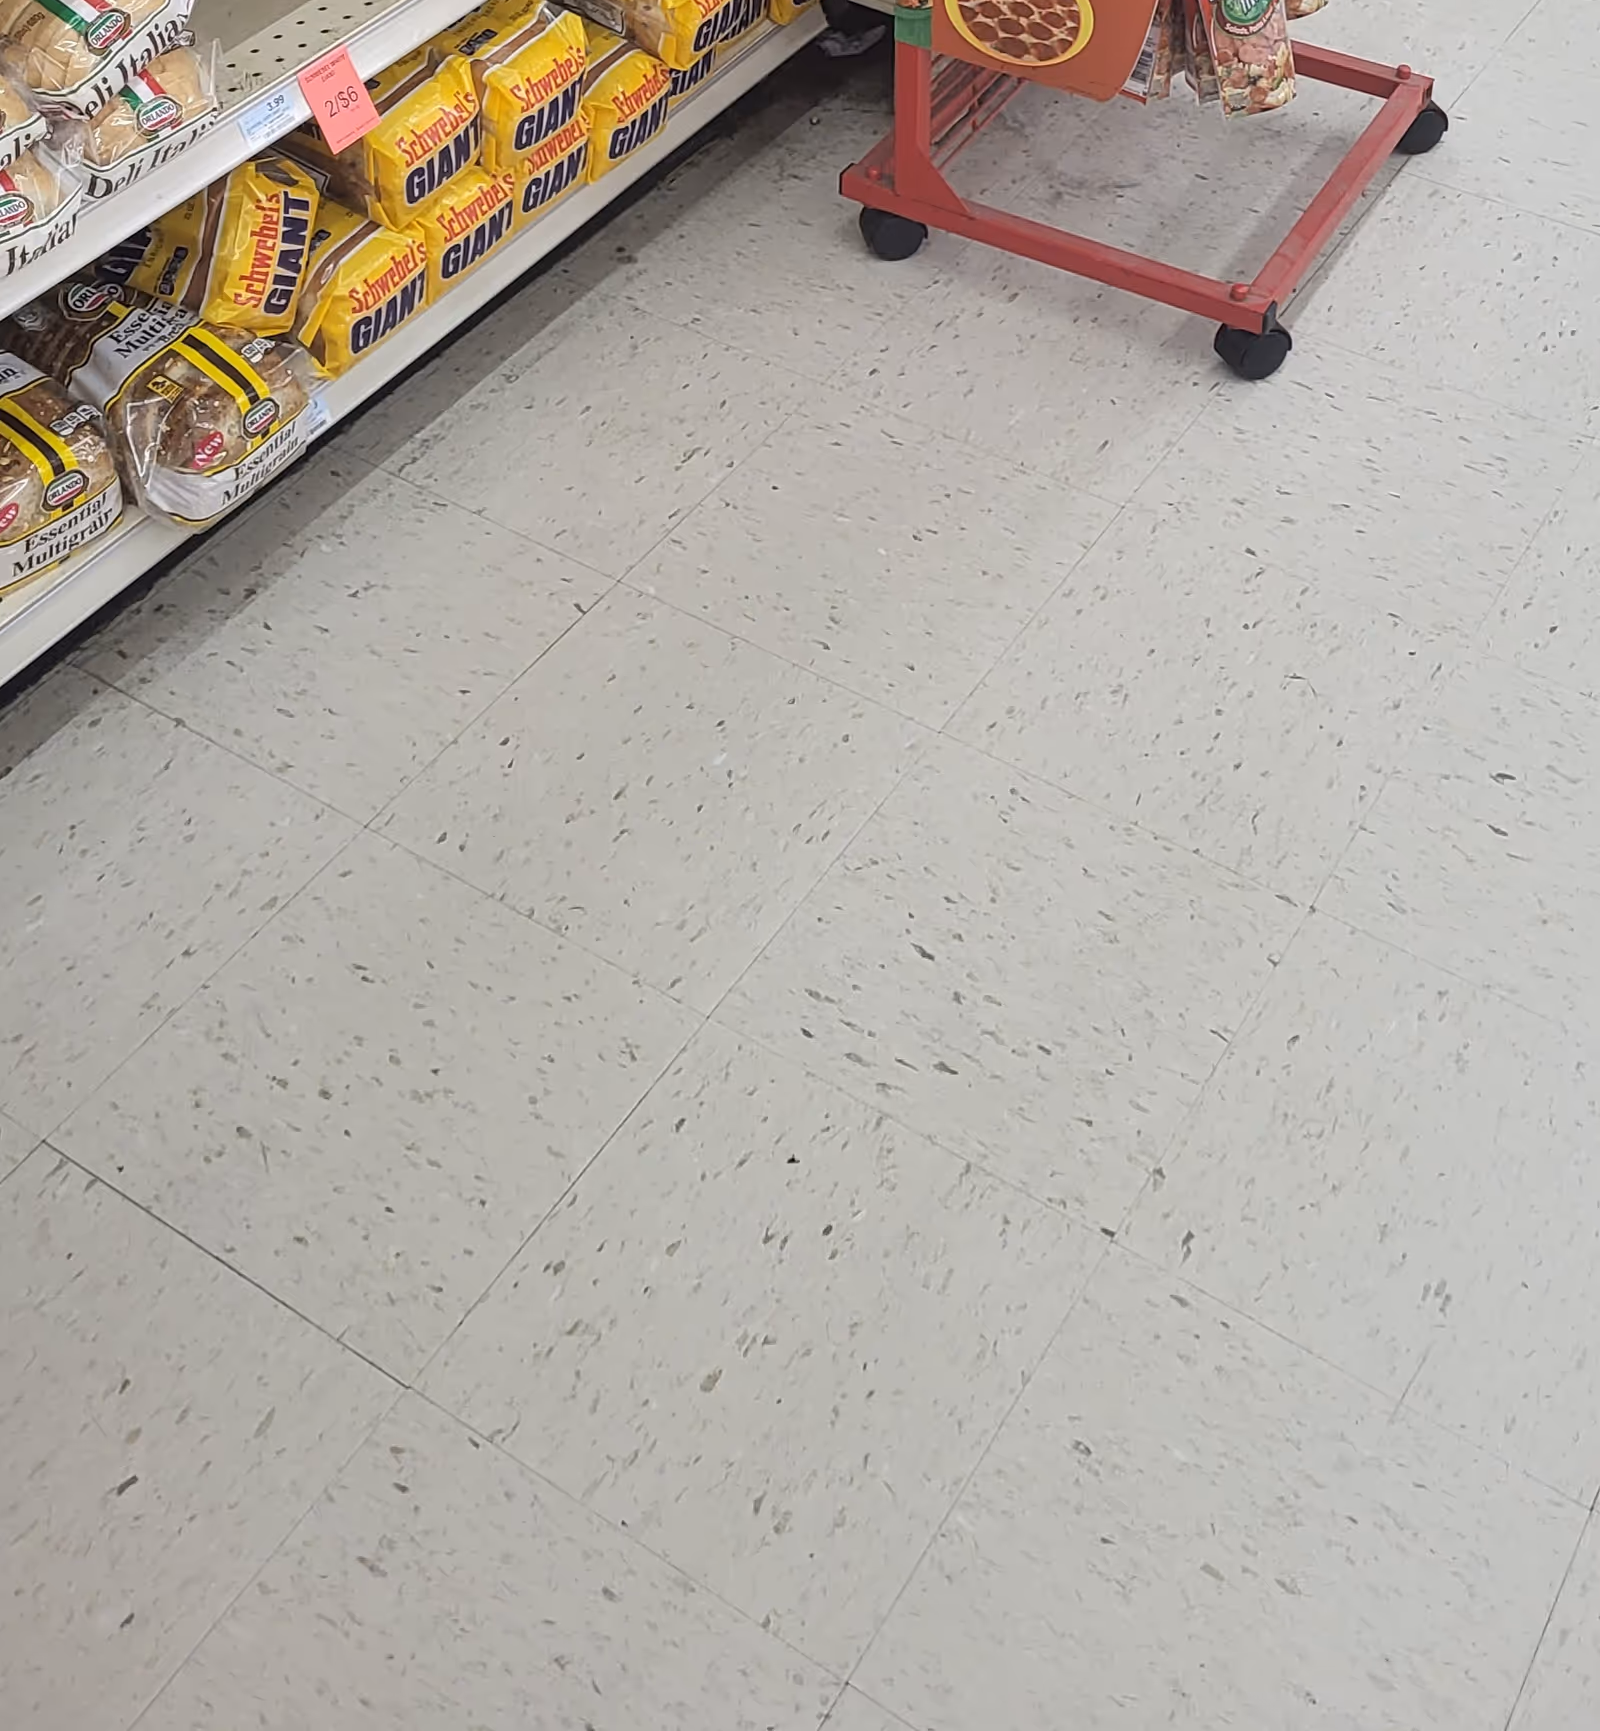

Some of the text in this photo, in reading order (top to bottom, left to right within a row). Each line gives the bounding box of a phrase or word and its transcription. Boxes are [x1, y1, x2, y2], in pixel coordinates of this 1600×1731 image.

[91, 15, 123, 46] ORLANDO
[266, 95, 285, 112] 3.99
[324, 85, 359, 118] 2/$6
[510, 45, 585, 112] Schwebel's
[514, 70, 584, 150] GIANT
[142, 103, 175, 127] ORLANDO
[395, 91, 477, 168] Schwebel's
[85, 158, 145, 199] Deli
[405, 113, 481, 204] GIANT
[436, 172, 516, 244] Schwebel's
[442, 200, 514, 279] GIANT
[233, 190, 281, 310] Schwebel's
[264, 190, 310, 315] GIANT
[349, 239, 428, 314] Schwebel's
[351, 268, 426, 354] GIANT
[197, 432, 224, 466] New
[246, 404, 274, 429] ORLANDO
[221, 436, 306, 505] Multigrain
[235, 420, 296, 481] Essential
[24, 491, 108, 554] Essential
[48, 478, 82, 502] ORLANDO
